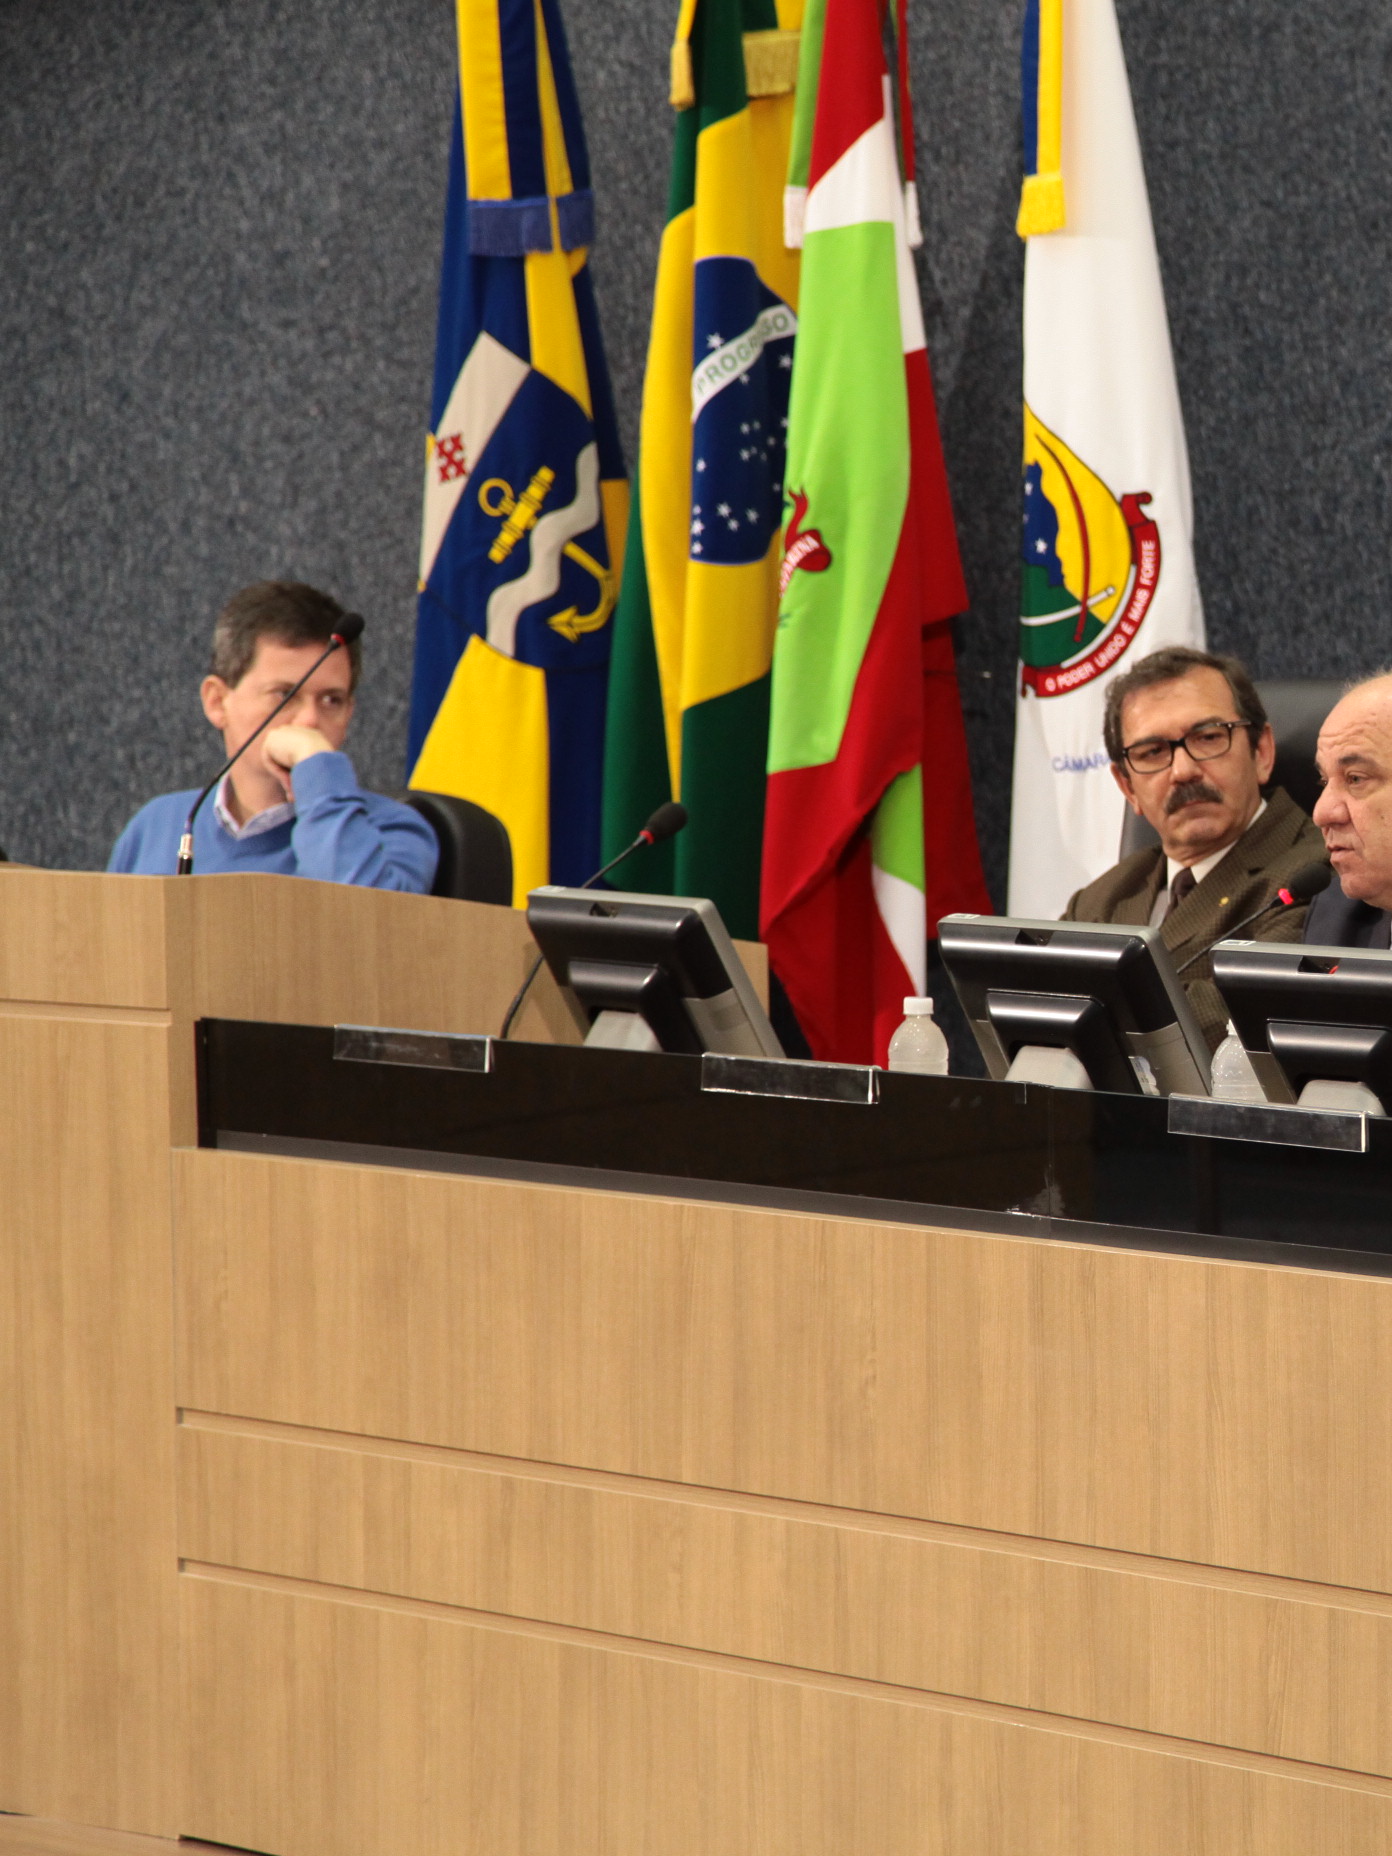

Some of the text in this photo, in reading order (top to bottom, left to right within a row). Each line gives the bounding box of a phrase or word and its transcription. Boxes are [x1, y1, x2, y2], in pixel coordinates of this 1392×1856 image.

[1044, 539, 1156, 692] O PODER UNIDO É MAIS FORTE
[1051, 752, 1111, 773] CÂMAR
